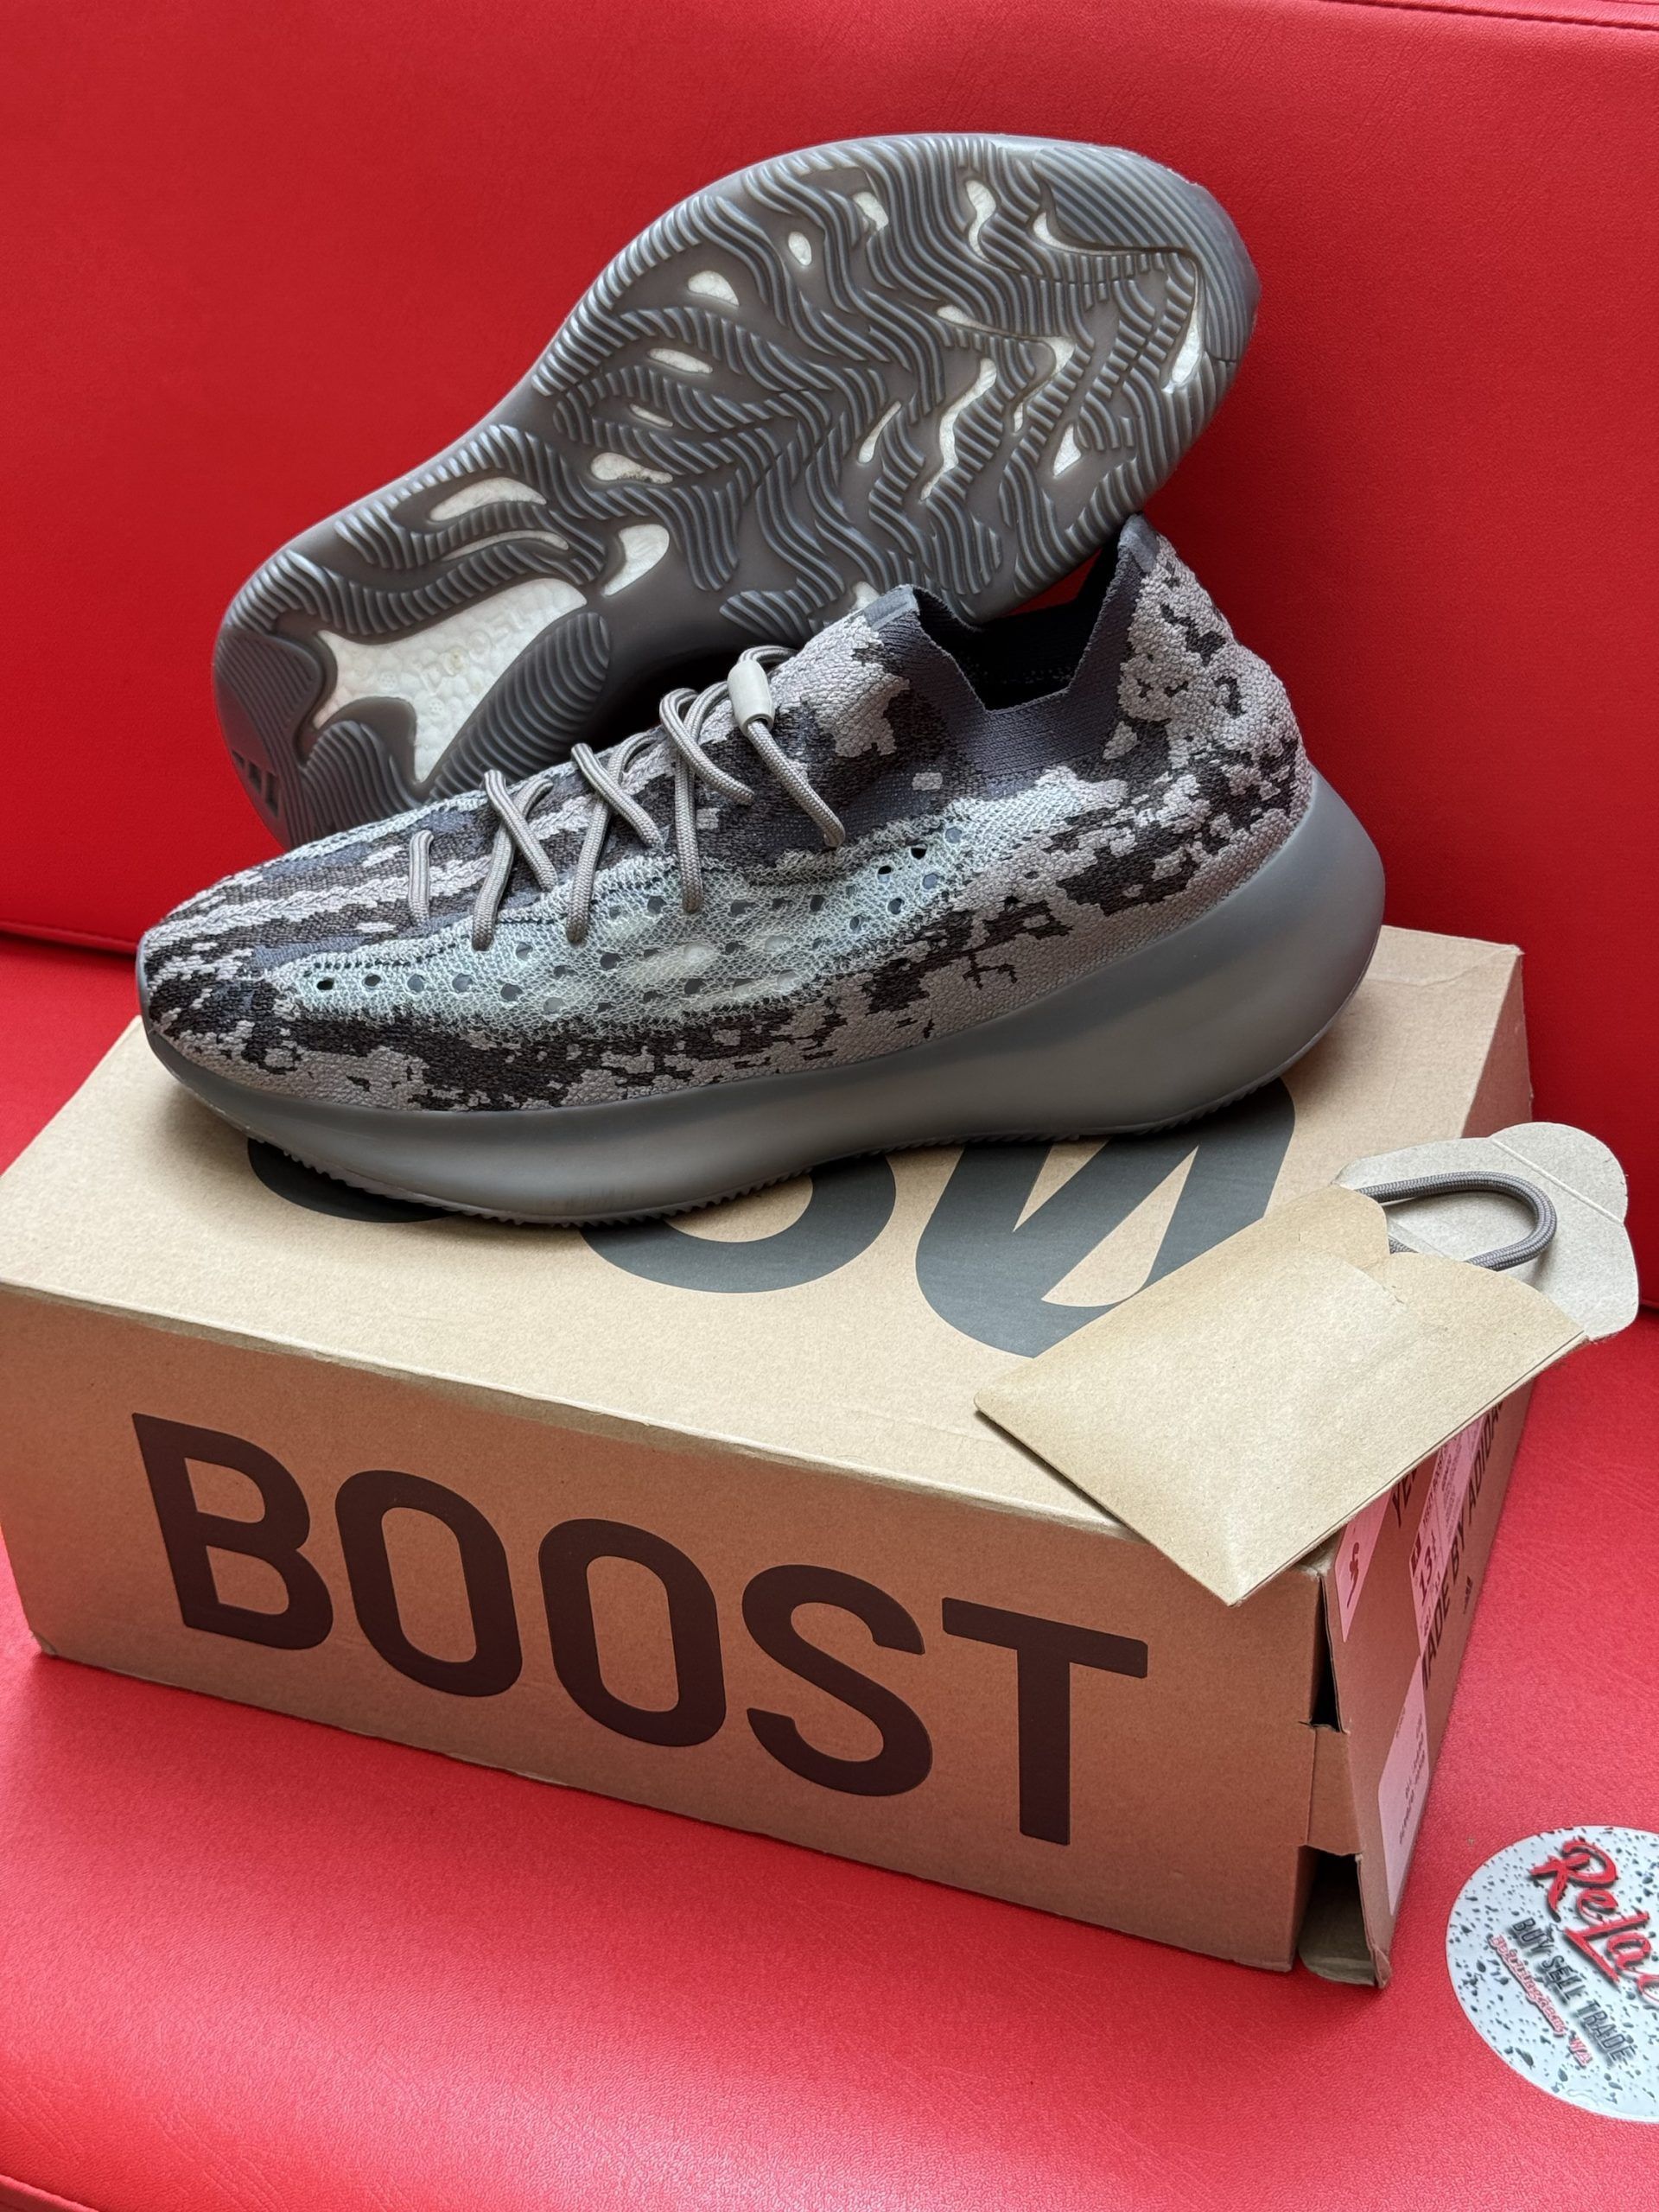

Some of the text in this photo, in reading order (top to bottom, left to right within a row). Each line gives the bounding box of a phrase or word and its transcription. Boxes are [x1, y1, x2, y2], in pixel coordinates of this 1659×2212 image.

[1451, 1507, 1465, 1585] BY
[1469, 1402, 1503, 1527] ADIDA
[131, 1413, 1148, 1847] BOOST
[1512, 1916, 1637, 2063] BUY SELL TRADE
[1567, 2036, 1593, 2066] WA
